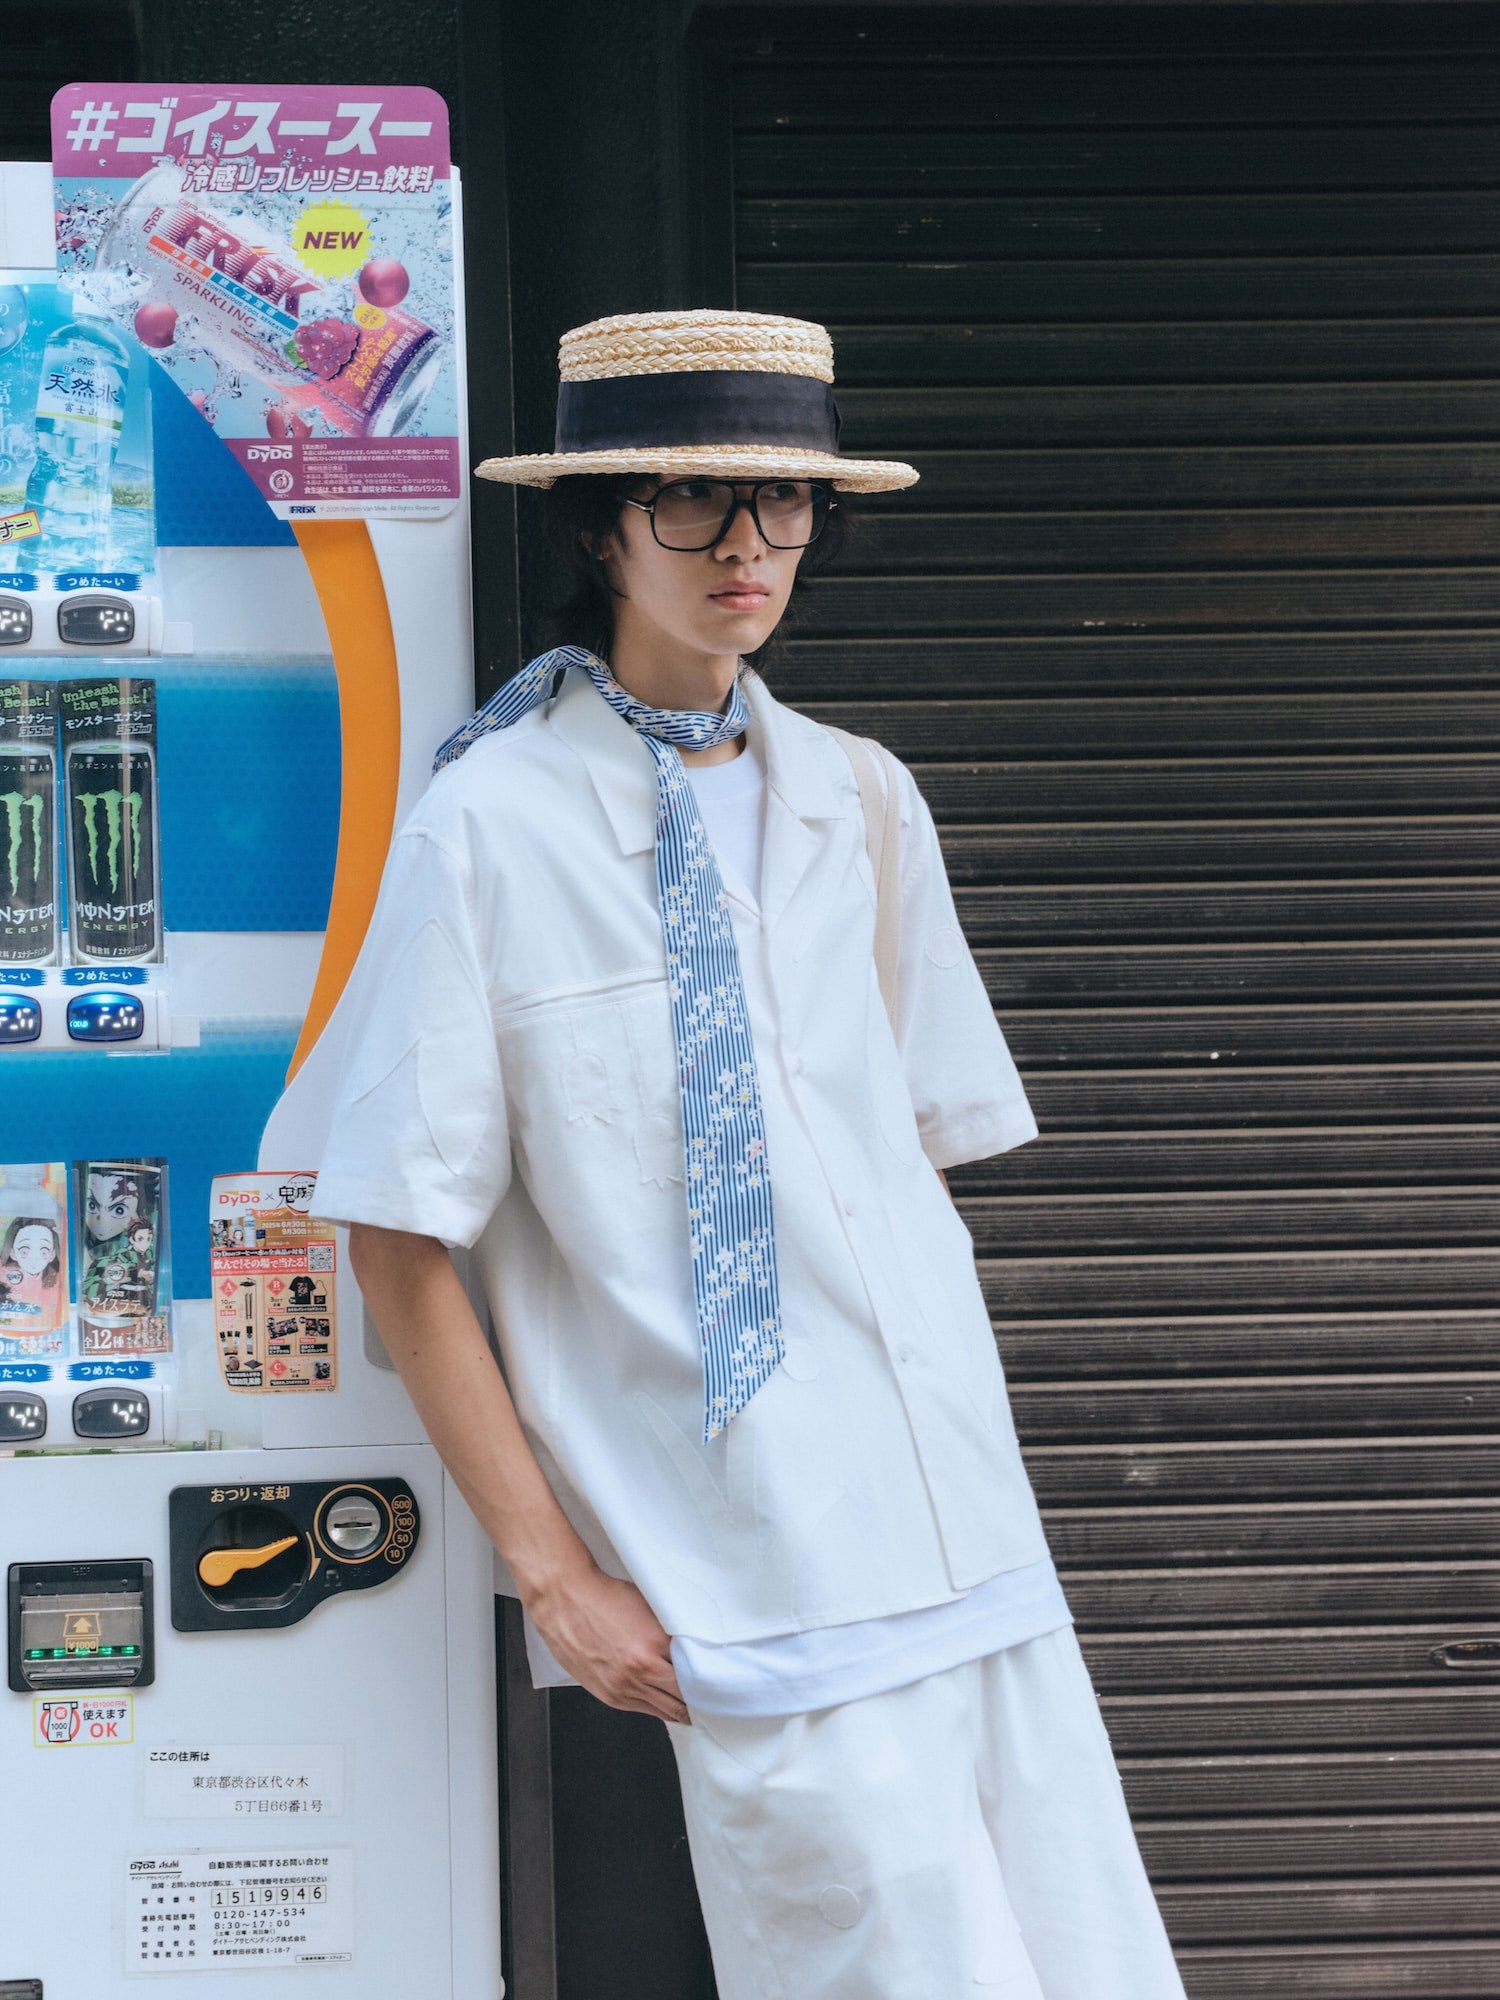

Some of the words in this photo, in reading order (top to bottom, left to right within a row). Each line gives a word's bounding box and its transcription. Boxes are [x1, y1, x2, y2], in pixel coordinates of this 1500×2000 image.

[66, 97, 432, 156] #ゴイスースー
[181, 165, 434, 193] 冷感リフレッシュ飲料
[303, 231, 364, 250] NEW
[173, 272, 257, 329] SPARKLING
[45, 373, 120, 403] 天然水
[65, 402, 98, 416] 富士山
[247, 445, 293, 463] DyDo
[289, 505, 317, 514] FRISK
[67, 577, 125, 587] つめた～い
[4, 690, 50, 708] Beast!
[62, 683, 119, 703] Unleash
[73, 700, 98, 711] the
[101, 688, 148, 707] Beast!
[65, 711, 152, 729] モンスターエナジー
[75, 900, 155, 921] MONSTER
[5, 923, 48, 934] ERGY
[82, 920, 148, 931] ENERGY
[74, 970, 133, 982] つめた～い
[219, 1189, 260, 1206] DyDo
[90, 1299, 142, 1313] アイスラテ
[83, 1329, 124, 1350] 全12種
[81, 1365, 139, 1376] つめた～い
[210, 1485, 290, 1503] おつり・返却
[394, 1500, 410, 1510] 500
[397, 1517, 413, 1526] 100
[397, 1534, 409, 1543] 50
[389, 1550, 401, 1559] 10
[83, 1709, 128, 1720] 使えます
[51, 1723, 68, 1731] 1000
[90, 1722, 118, 1739] OK
[150, 1751, 210, 1762] ここの住所は
[192, 1775, 309, 1789] 東京都渋谷区代々木
[235, 1799, 323, 1813] 5丁目66番1号
[130, 1861, 156, 1871] DyDo
[209, 1858, 329, 1870] 自動販売機に関するお問い合わせ
[216, 1886, 322, 1905] 1519946
[214, 1908, 305, 1919] 0120-147-534
